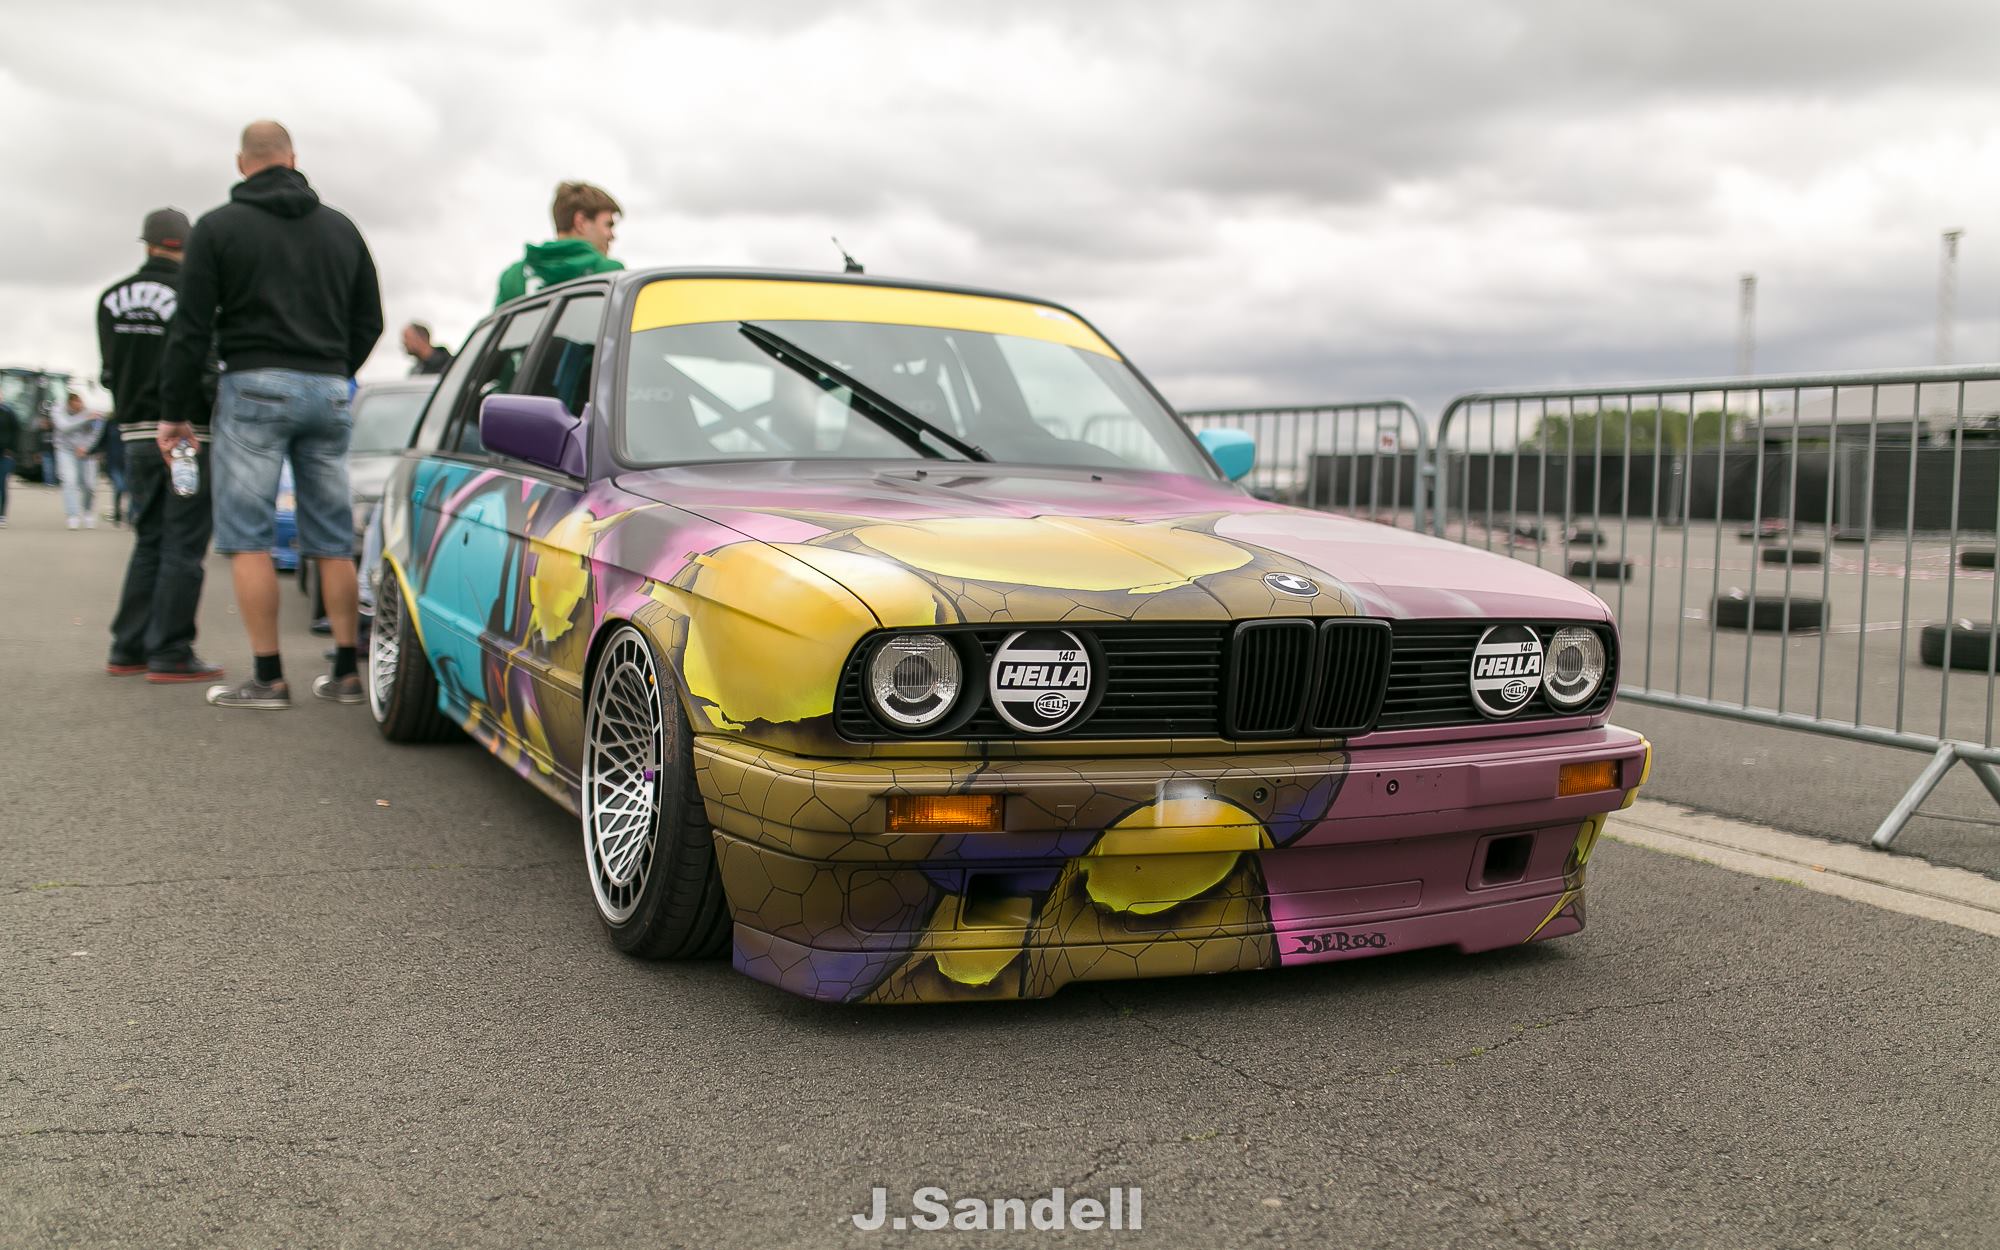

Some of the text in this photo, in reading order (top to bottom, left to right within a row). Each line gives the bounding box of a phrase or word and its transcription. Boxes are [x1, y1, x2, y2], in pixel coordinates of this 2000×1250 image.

[1520, 643, 1534, 652] 140
[1058, 651, 1076, 661] 140
[1476, 655, 1540, 677] HELLA
[1000, 665, 1086, 687] HELLA
[1505, 685, 1528, 694] HELLA
[1039, 699, 1069, 710] HELLA
